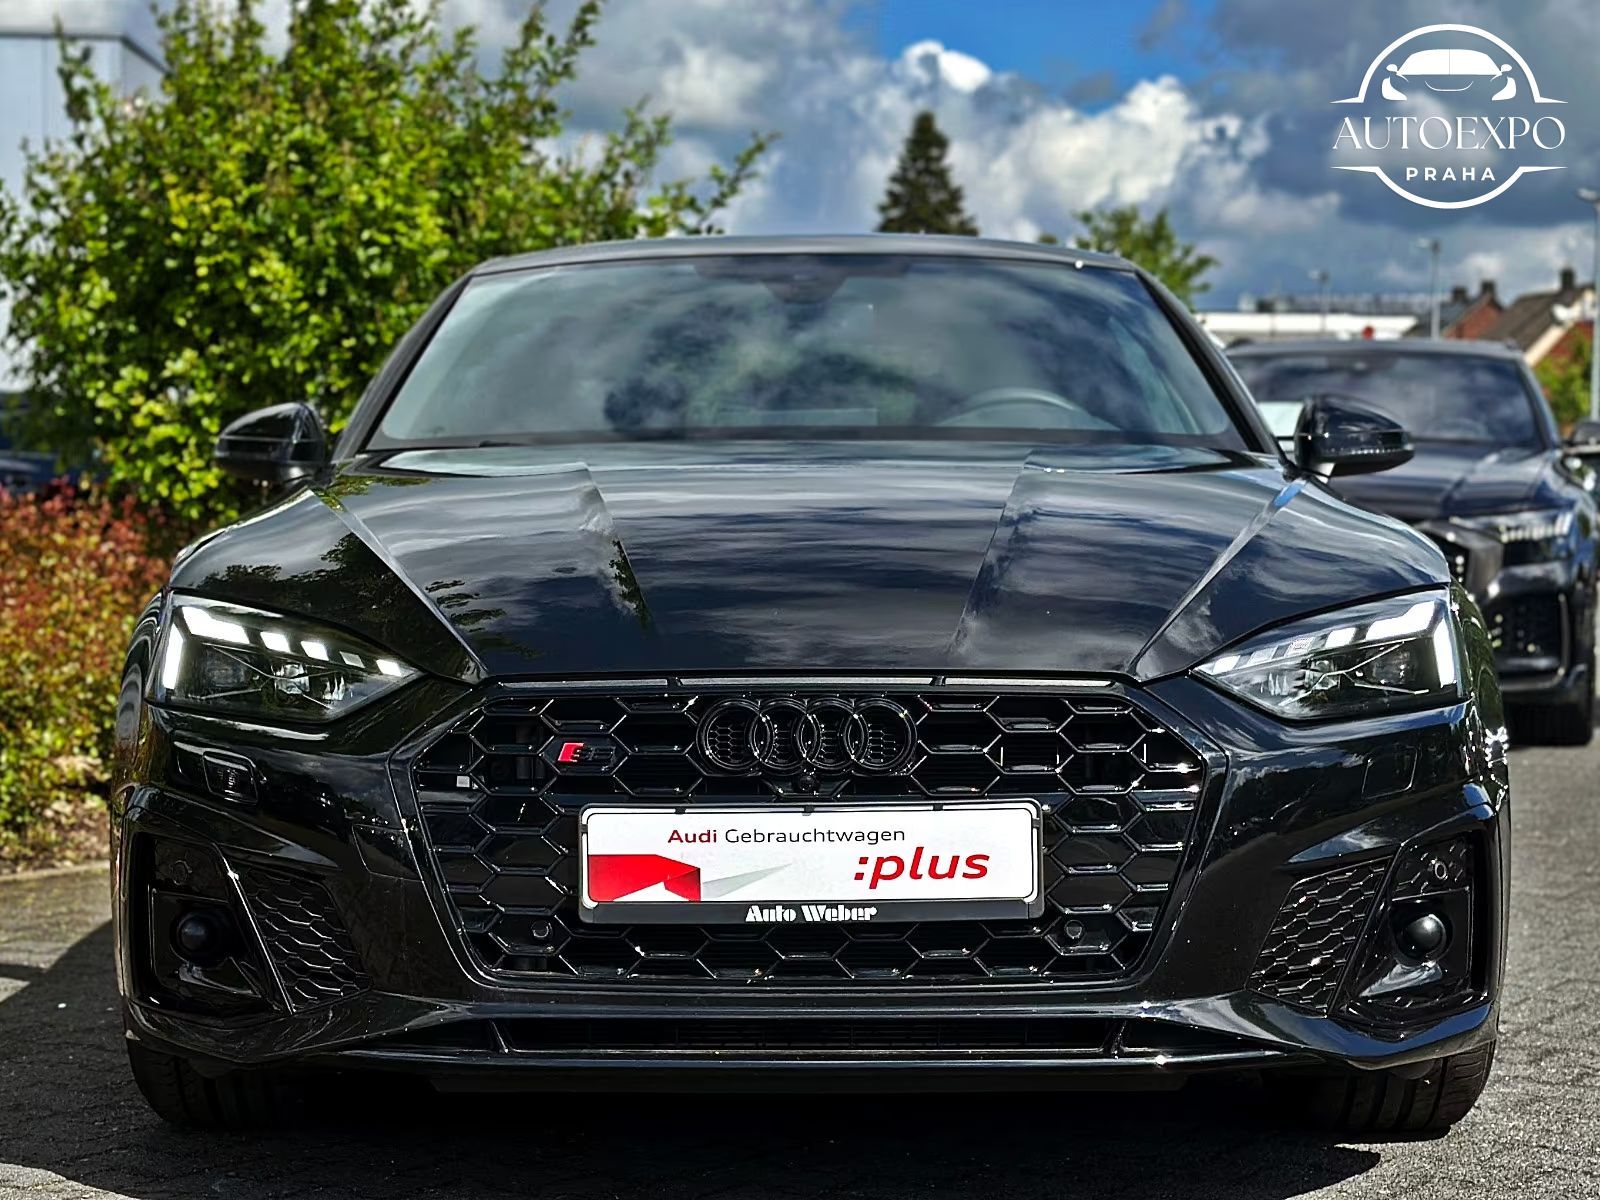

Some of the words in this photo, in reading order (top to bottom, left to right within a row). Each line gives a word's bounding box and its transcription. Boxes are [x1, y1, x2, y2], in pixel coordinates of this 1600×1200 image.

[667, 828, 718, 844] Audi
[725, 827, 906, 845] Gebrauchtwagen
[853, 846, 991, 890] :plus
[745, 904, 797, 923] Auto
[801, 904, 878, 923] Weber
